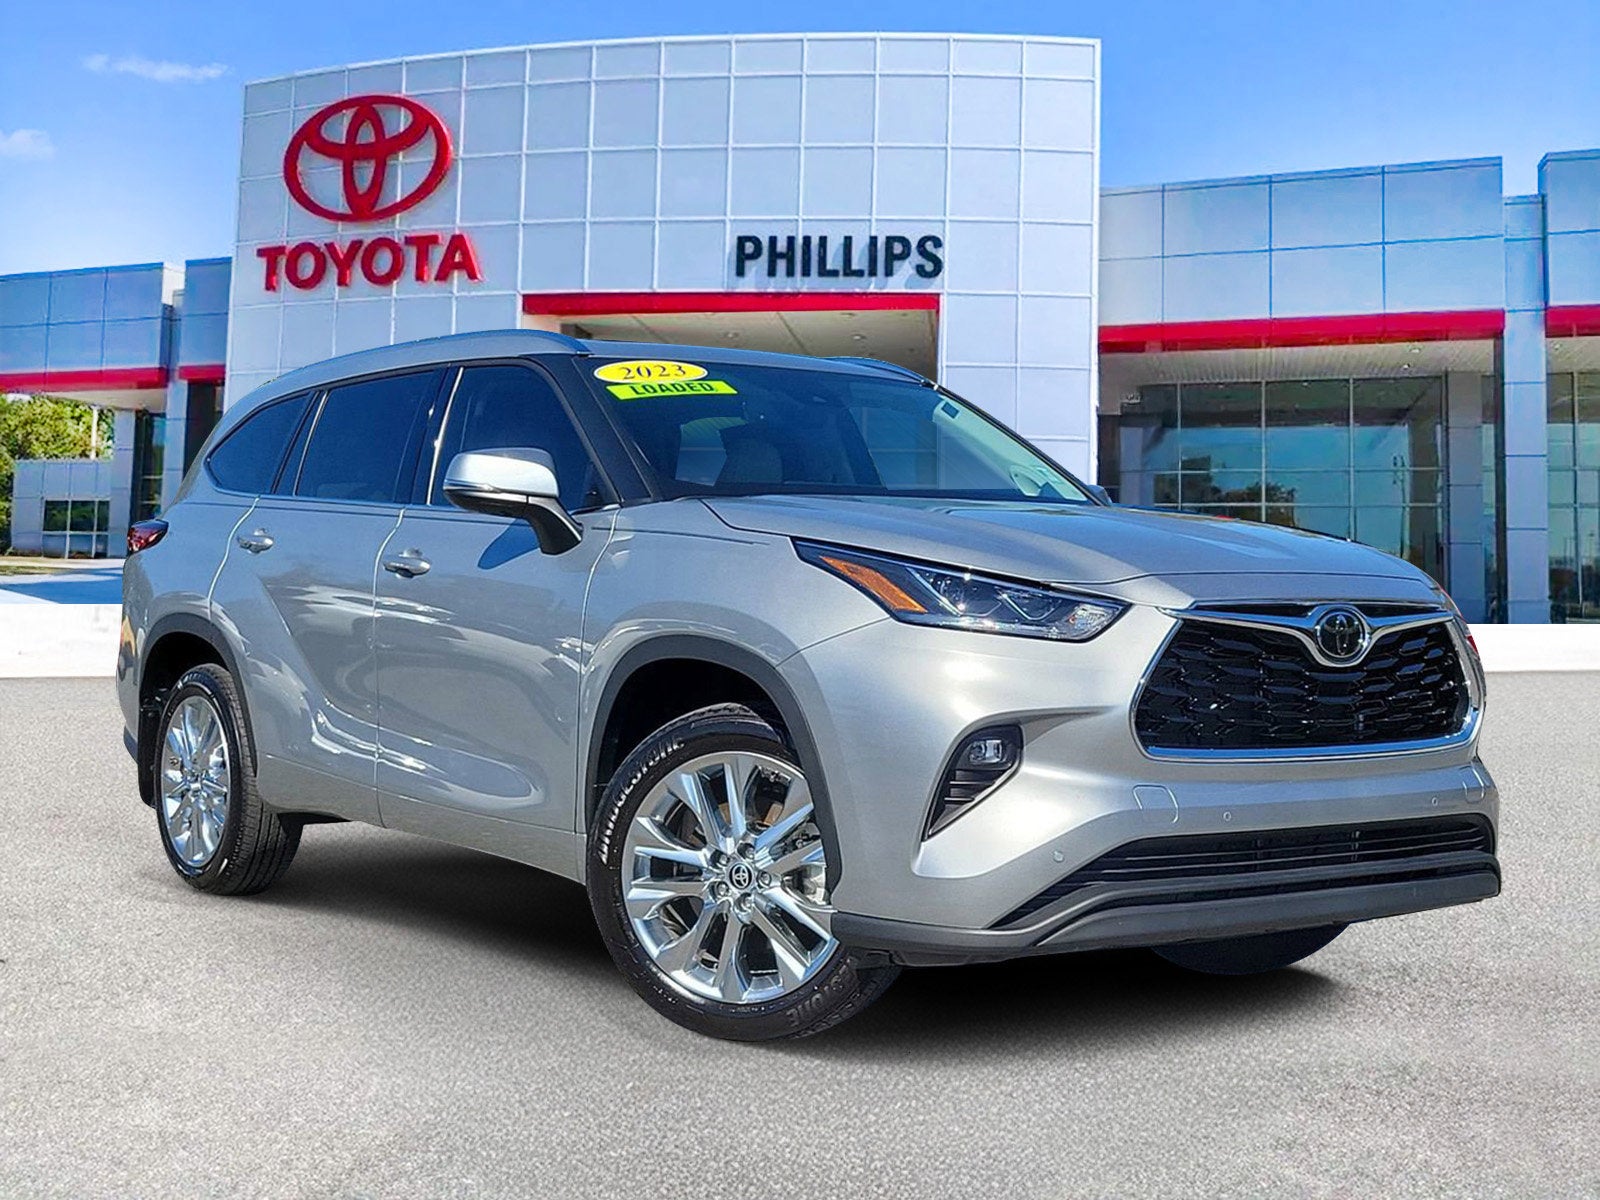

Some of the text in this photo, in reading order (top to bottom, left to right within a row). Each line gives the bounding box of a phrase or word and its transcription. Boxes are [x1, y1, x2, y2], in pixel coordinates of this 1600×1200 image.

[257, 233, 481, 291] TOYOTA
[736, 235, 943, 278] PHILLIPS
[620, 364, 687, 380] 2023
[629, 382, 715, 395] LOADED
